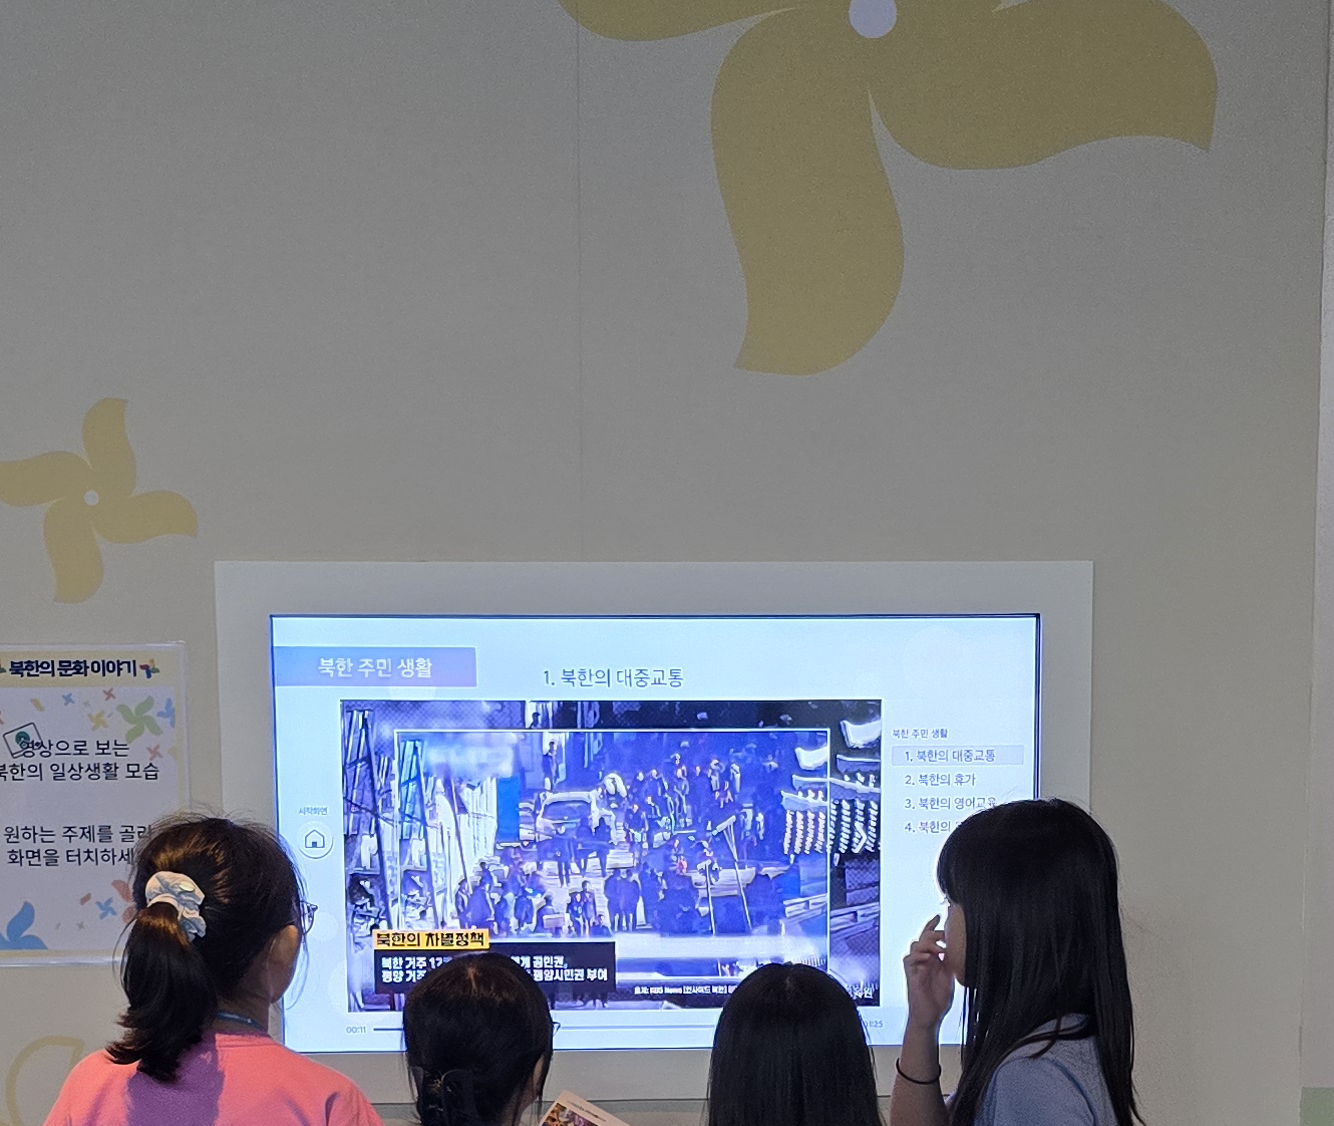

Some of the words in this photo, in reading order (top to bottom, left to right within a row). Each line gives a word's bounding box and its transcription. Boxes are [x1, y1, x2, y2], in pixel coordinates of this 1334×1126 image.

[9, 659, 55, 677] 북한의
[57, 660, 89, 677] 문화
[90, 659, 137, 677] 이야기
[317, 657, 353, 678] 북한
[357, 657, 392, 677] 주민
[397, 657, 432, 678] 생활
[543, 669, 555, 686] 1.
[561, 668, 611, 688] 북한의
[616, 668, 684, 687] 대중교통
[892, 729, 909, 739] 북한
[911, 728, 928, 739] 주민
[931, 728, 948, 739] 생활
[20, 740, 90, 758] 영상으로
[95, 740, 130, 758] 보는
[905, 750, 914, 762] 1.
[917, 749, 949, 762] 북한의
[952, 749, 995, 762] 대중교통
[49, 763, 119, 781] 일상생활
[125, 763, 160, 782] 모습
[904, 775, 915, 785] 2.
[919, 773, 951, 786] 북한의
[954, 773, 976, 786] 휴가
[904, 798, 915, 809] 3.
[919, 797, 951, 810] 북한의
[3, 825, 56, 844] 원하는
[62, 825, 114, 843] 주제를
[904, 822, 915, 833] 4.
[919, 821, 951, 834] 북한의
[7, 848, 60, 867] 화면을
[66, 848, 135, 867] 터치하세
[377, 932, 420, 947] 북한의
